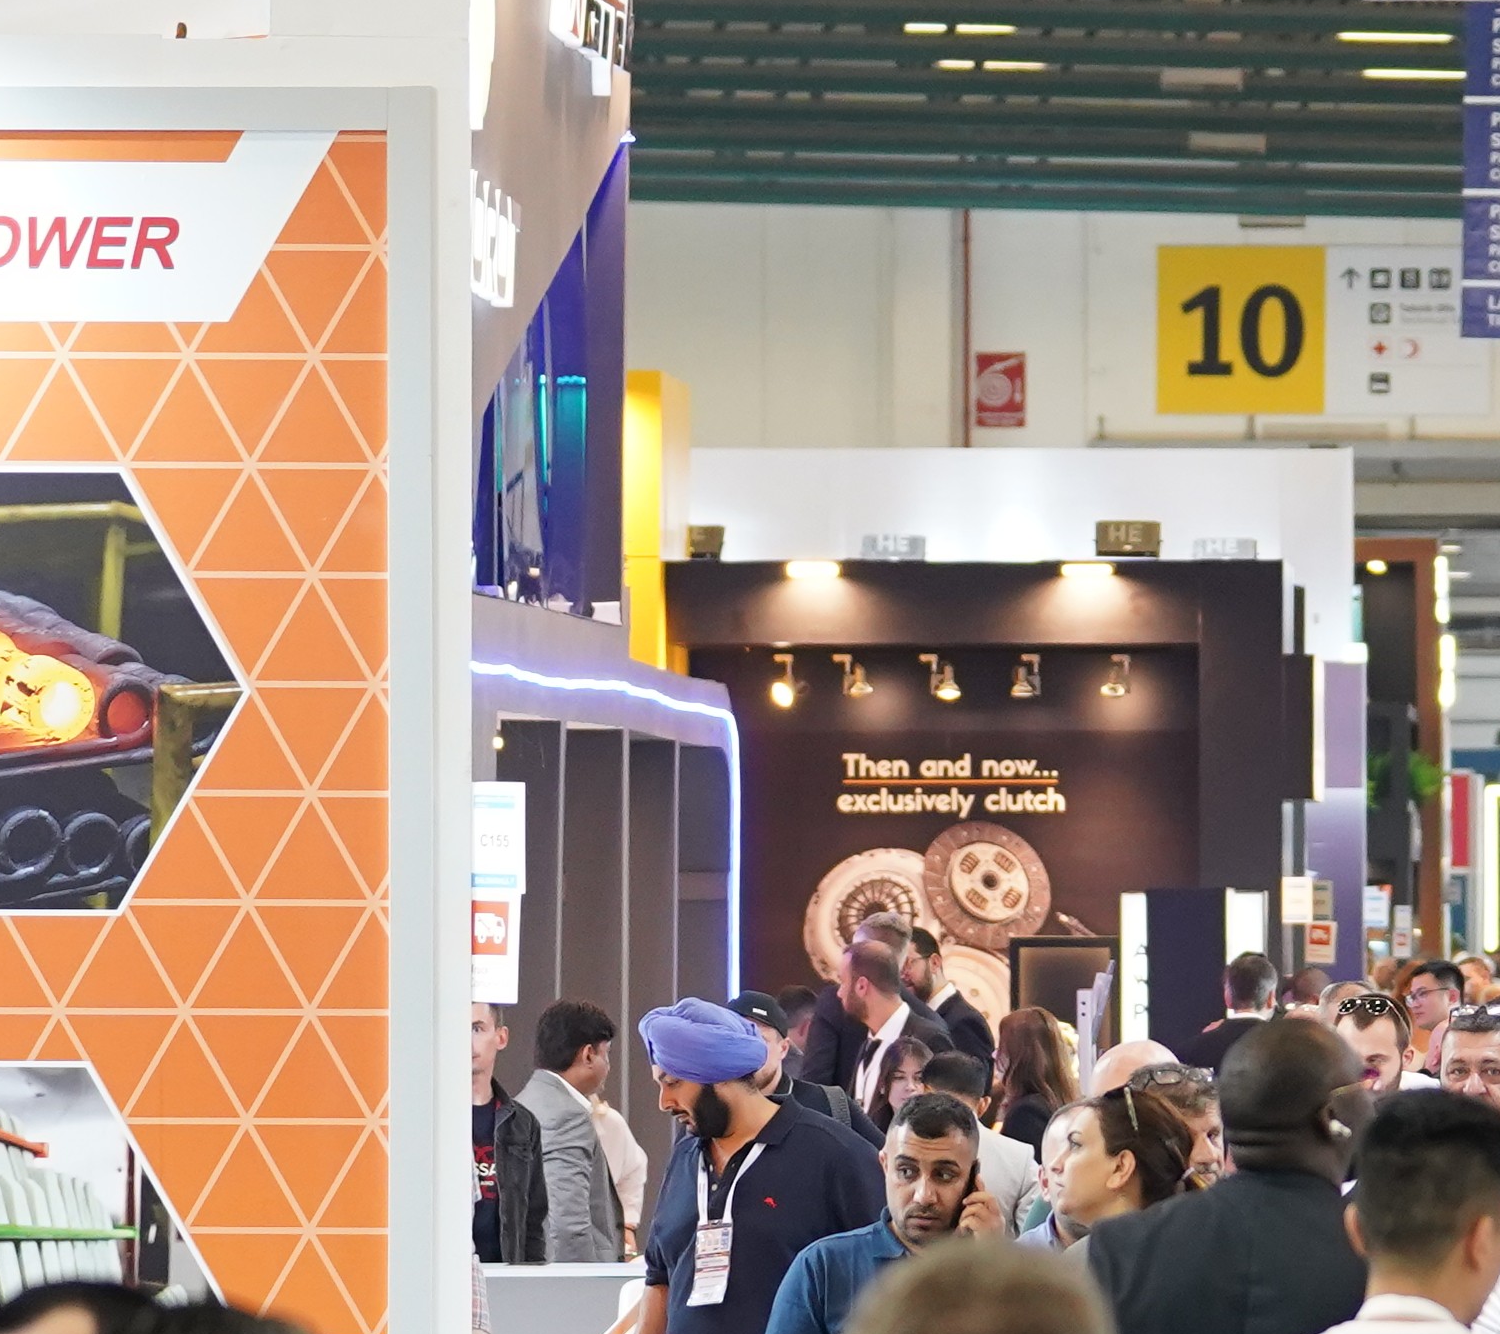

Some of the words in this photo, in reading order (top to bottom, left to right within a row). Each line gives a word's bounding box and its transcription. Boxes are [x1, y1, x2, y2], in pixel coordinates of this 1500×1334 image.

[1182, 285, 1304, 377] 10
[842, 753, 911, 778] Then
[919, 753, 972, 778] and
[981, 758, 1059, 778] now...
[836, 786, 976, 819] exclusively
[983, 786, 1067, 813] clutch
[480, 833, 510, 848] C155
